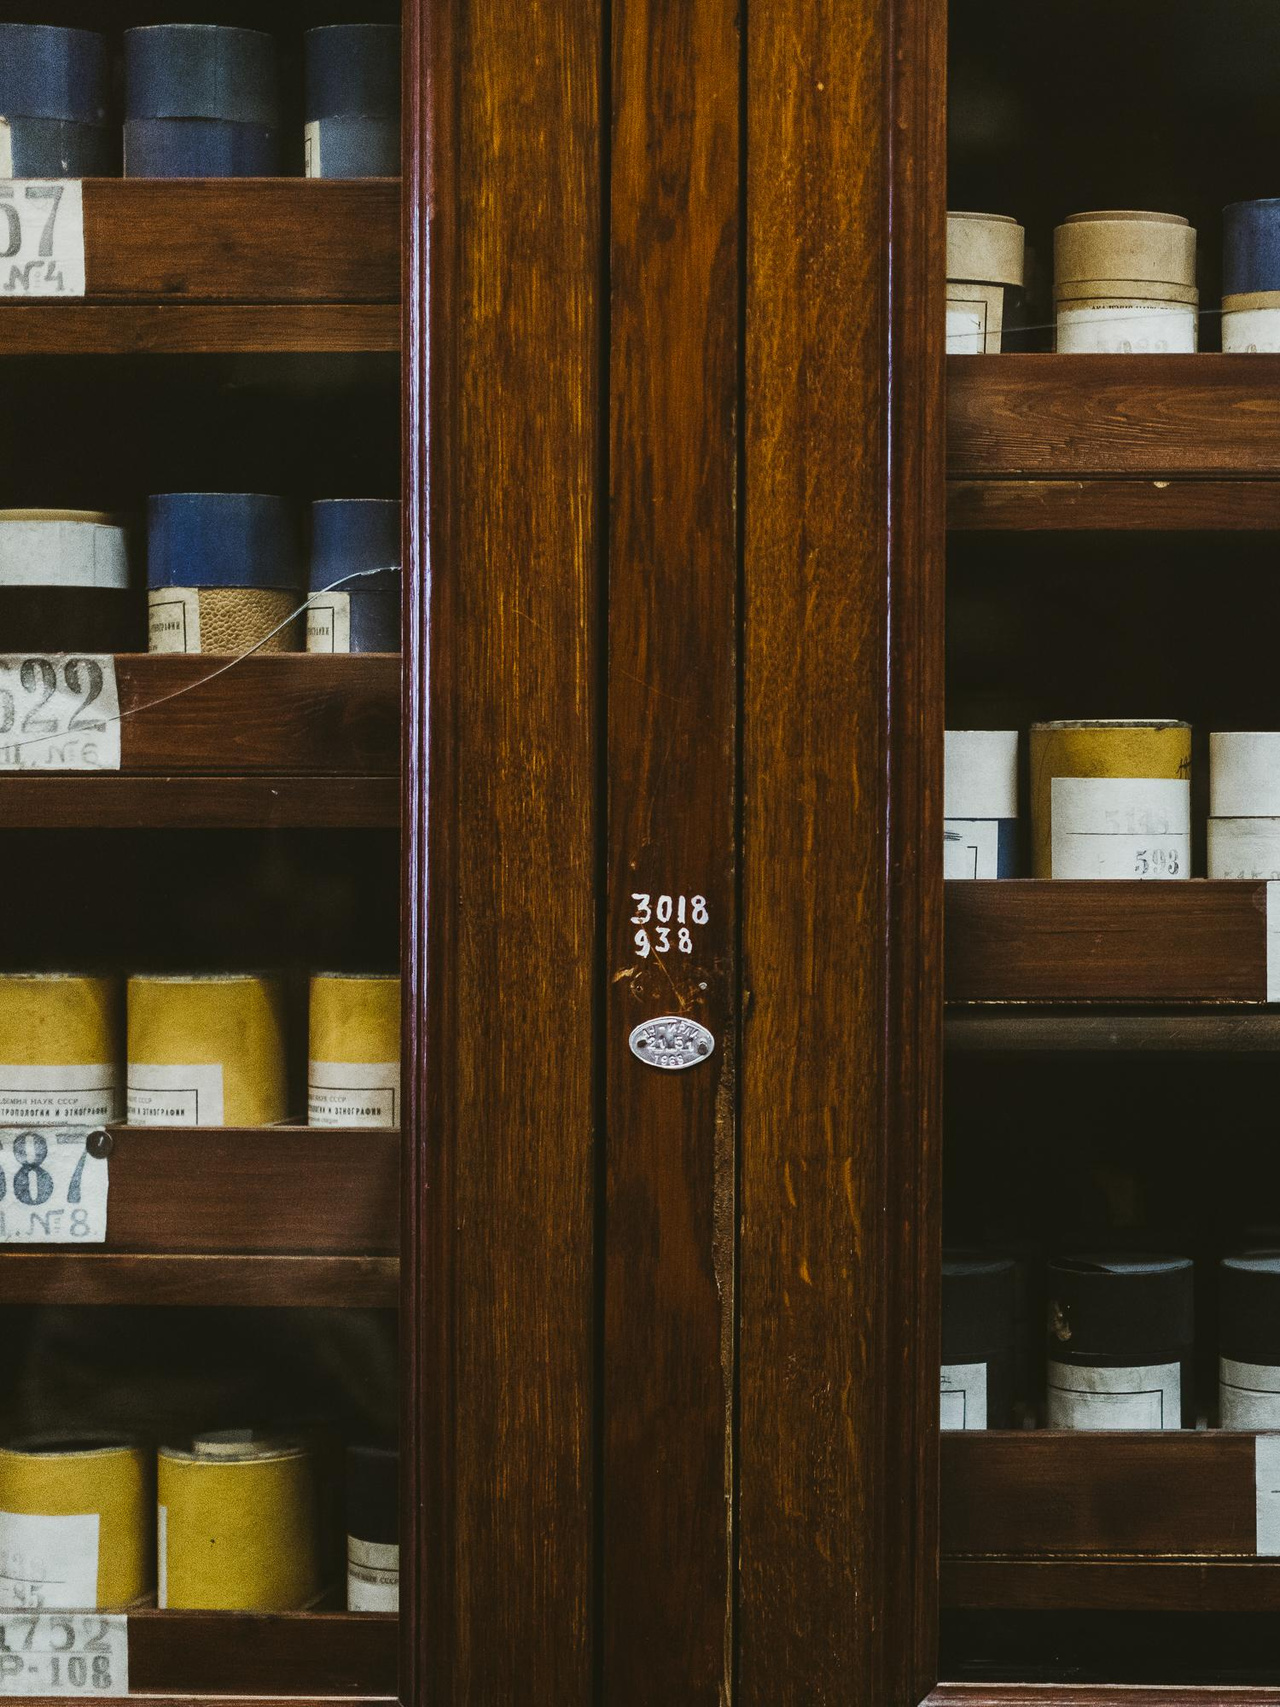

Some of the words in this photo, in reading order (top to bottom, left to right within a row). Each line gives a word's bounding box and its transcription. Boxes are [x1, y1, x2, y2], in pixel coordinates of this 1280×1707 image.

[1134, 849, 1180, 875] 593
[631, 893, 709, 925] 3018
[634, 926, 693, 958] 938
[0, 1131, 90, 1206] 87
